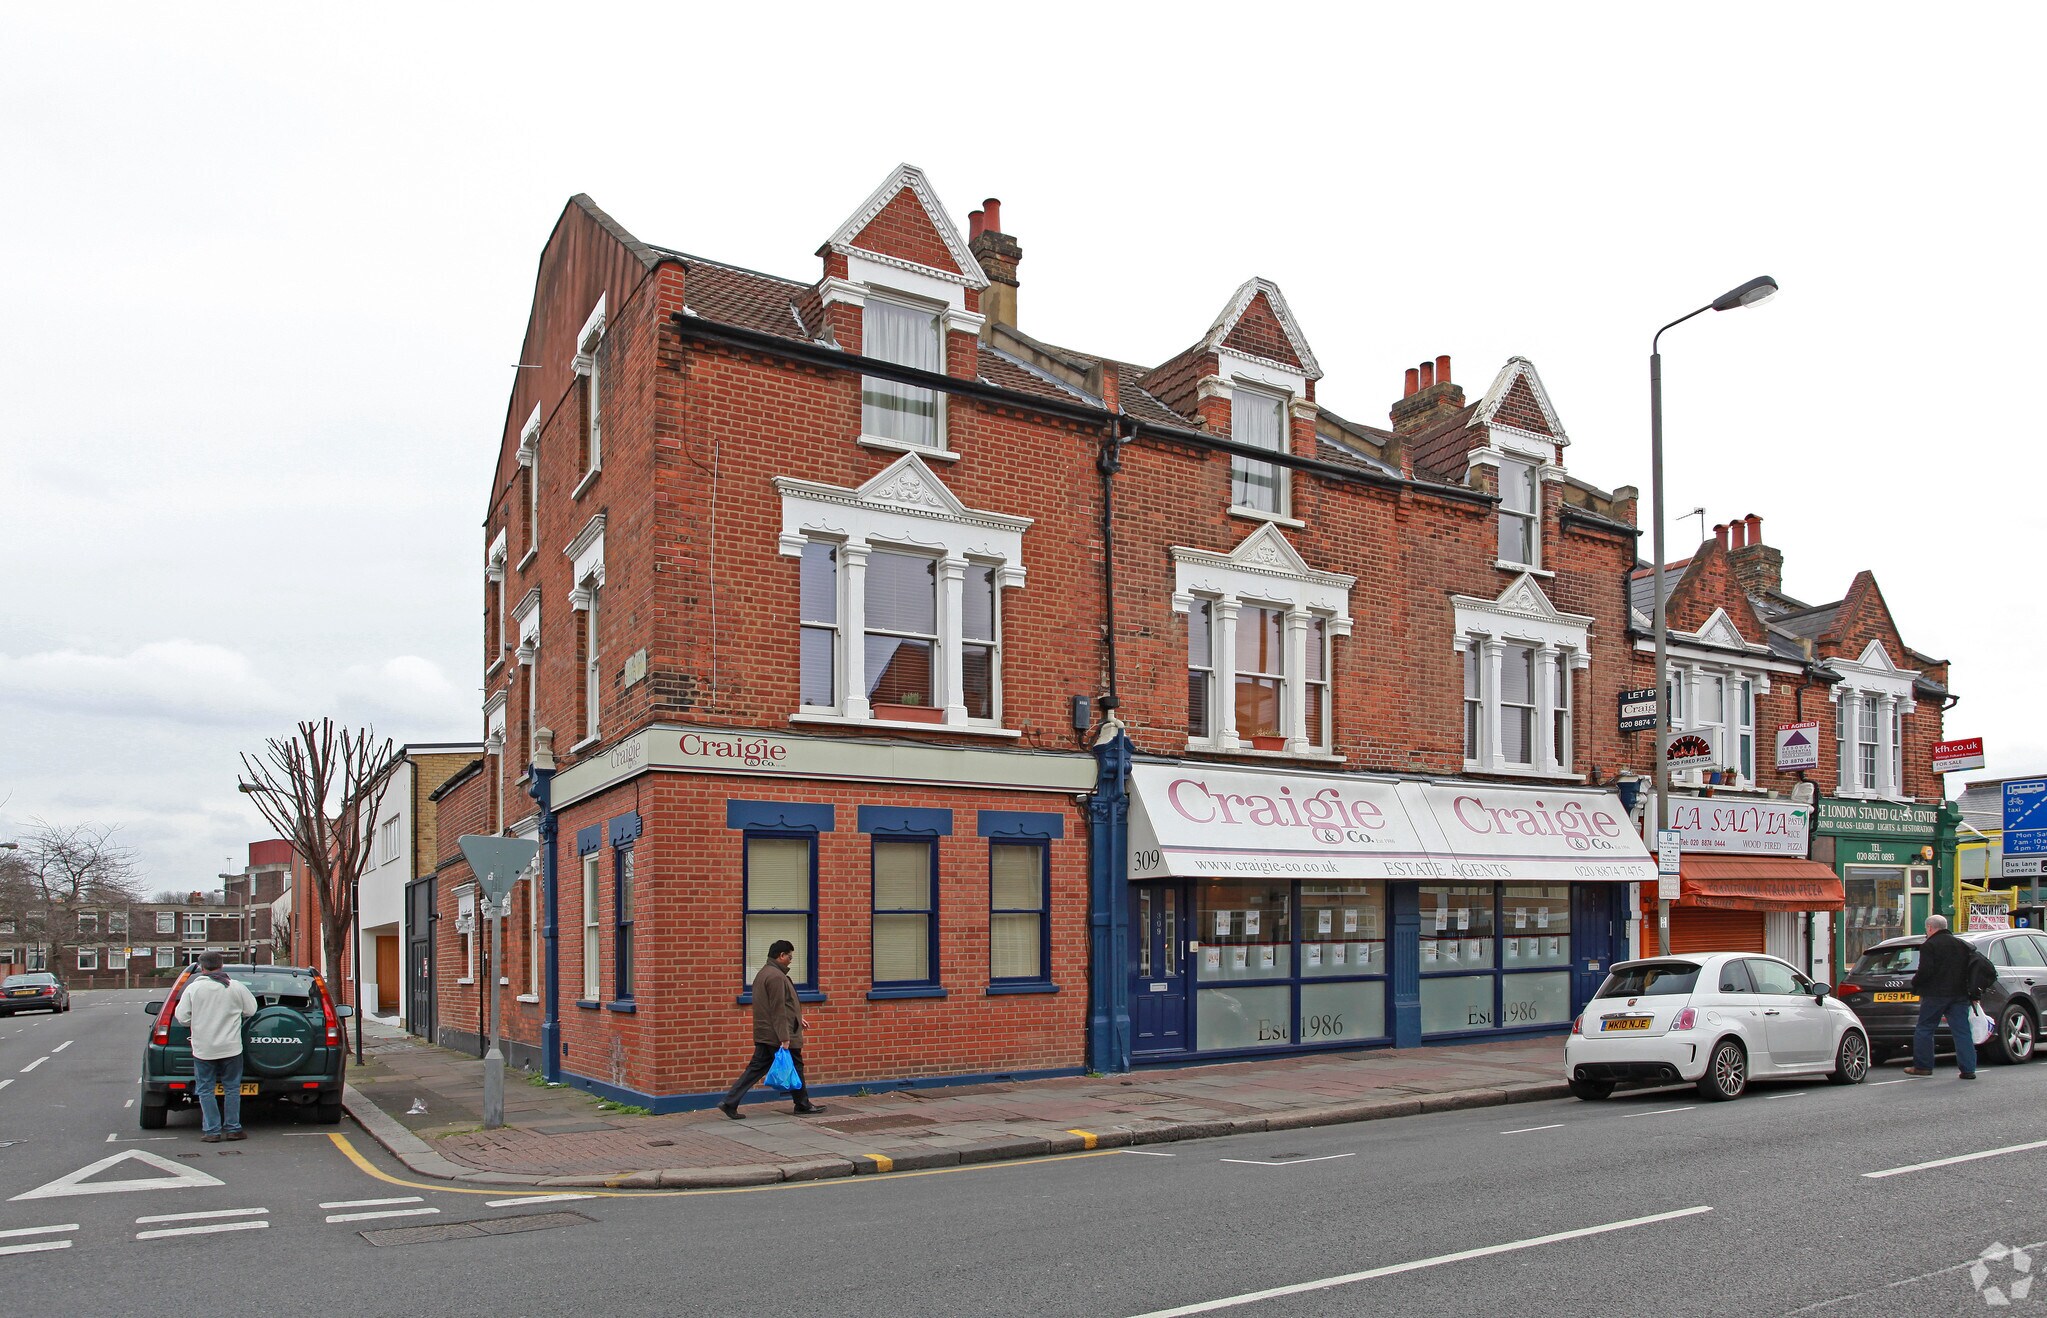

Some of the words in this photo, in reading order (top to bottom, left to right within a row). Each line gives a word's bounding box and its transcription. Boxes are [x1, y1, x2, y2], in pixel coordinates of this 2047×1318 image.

[1628, 690, 1645, 700] LET
[1624, 703, 1656, 714] Craig
[1620, 720, 1633, 728] 020
[1634, 719, 1650, 727] 8874
[1790, 721, 1816, 729] AGREED
[610, 738, 641, 768] Craigie
[679, 734, 787, 766] Craigie
[1935, 741, 1978, 754] kfh.co.uk
[762, 759, 775, 767] Co.
[1167, 778, 1386, 845] Craigie
[1828, 805, 1857, 818] LONDON
[1858, 807, 1888, 821] STAINED
[1890, 810, 1913, 822] GLASS
[1914, 810, 1938, 823] CENTRE
[1453, 795, 1621, 851] Craigie
[1671, 806, 1702, 830] LA
[1710, 807, 1787, 835] SALVIA
[1787, 817, 1805, 826] PASTA
[1877, 823, 1895, 832] LIGHTS
[1896, 824, 1901, 832] &
[1902, 824, 1935, 833] RESTORATION
[1324, 829, 1336, 842] &
[1346, 830, 1375, 843] Co.
[1787, 830, 1801, 838] RICE
[1574, 837, 1586, 848] &
[1591, 838, 1614, 850] Co.
[1701, 839, 1713, 847] 8874
[1742, 840, 1762, 849] WOOD
[1763, 841, 1782, 850] FIRED
[1787, 842, 1803, 851] PIZZA
[1133, 849, 1160, 872] 309
[1868, 853, 1880, 861] 8871
[1195, 858, 1340, 875] www.craigie-co.co.uk
[1383, 861, 1447, 877] ESTATE
[1451, 863, 1512, 878] AGENTS
[1574, 865, 1595, 877] 020
[1594, 866, 1620, 877] 8874
[1620, 866, 1646, 877] 7475
[2006, 866, 2037, 874] cameras
[1707, 883, 1762, 896] TRADITIONAL
[1765, 883, 1795, 896] ITALIAN
[1799, 884, 1822, 897] PIZZA
[2019, 917, 2027, 928] P
[1877, 993, 1898, 1001] GY59
[1468, 1004, 1492, 1026] Est
[1502, 1000, 1538, 1022] 1986
[1257, 1018, 1288, 1042] Est
[1301, 1013, 1344, 1038] 1986
[1608, 1020, 1628, 1030] MK10
[1628, 1020, 1648, 1029] NJE
[250, 1036, 303, 1044] HONDA
